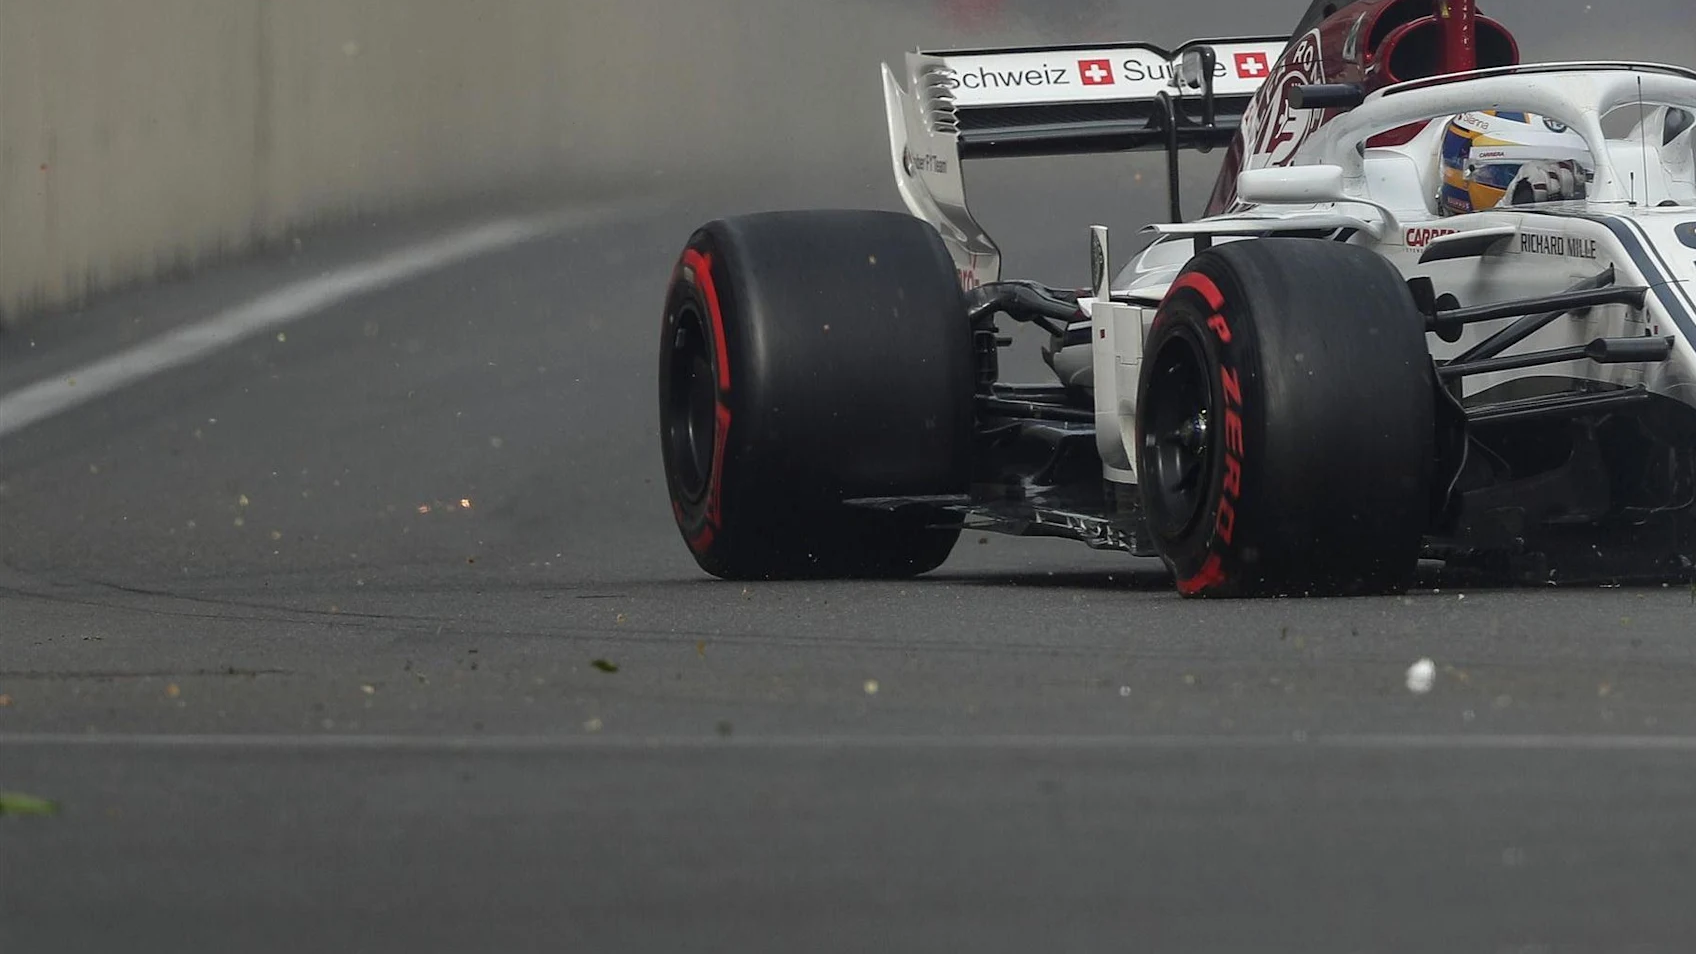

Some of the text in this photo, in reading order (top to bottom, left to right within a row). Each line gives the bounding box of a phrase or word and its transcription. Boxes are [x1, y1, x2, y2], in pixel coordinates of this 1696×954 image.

[948, 59, 1228, 90] Schweiz Suie
[1520, 232, 1597, 260] RICHARD MILLE
[1207, 313, 1245, 546] P ZERO
